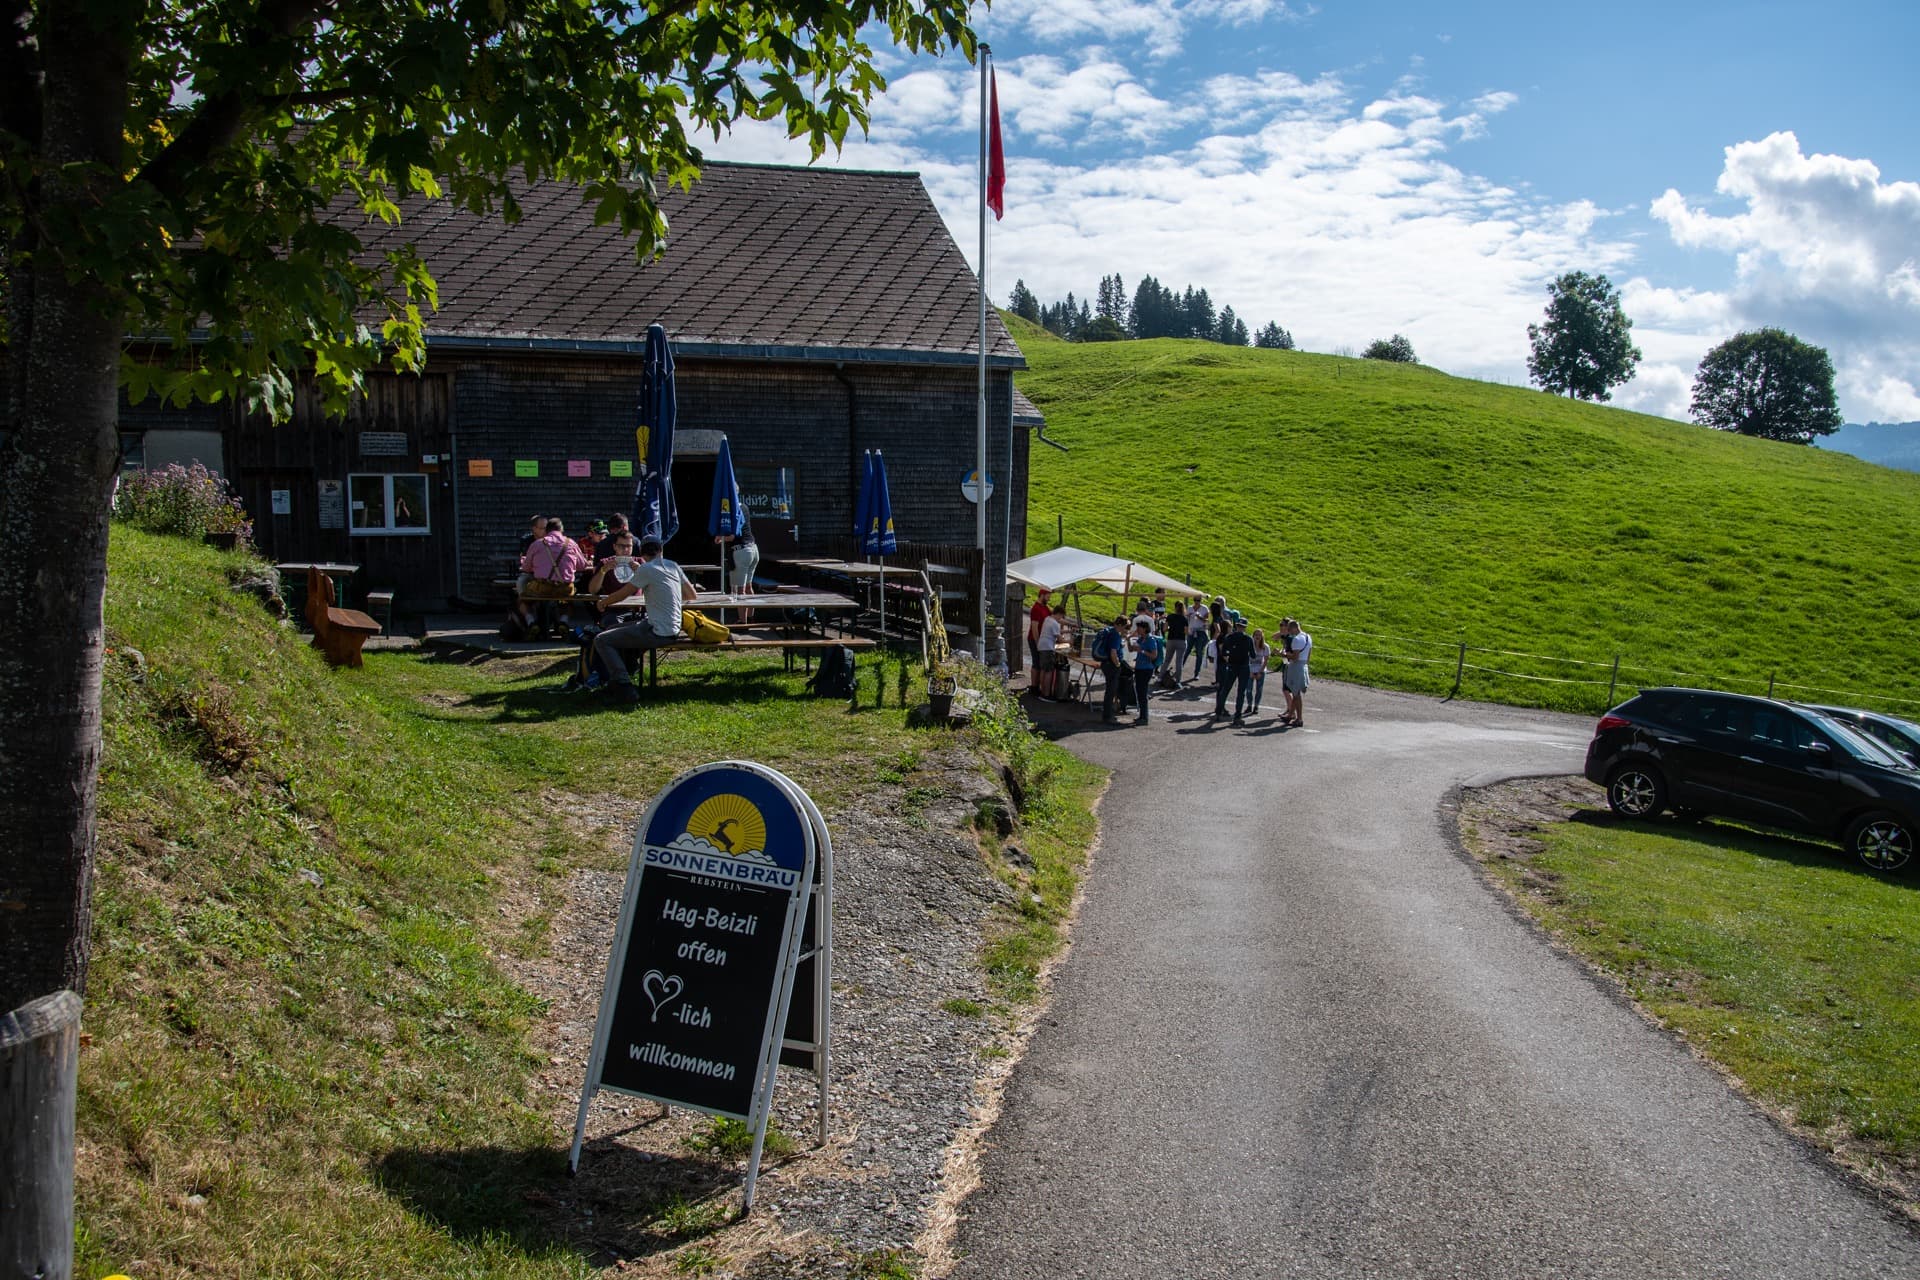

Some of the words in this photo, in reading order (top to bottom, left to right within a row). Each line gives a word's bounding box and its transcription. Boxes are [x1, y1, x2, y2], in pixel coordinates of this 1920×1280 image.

[645, 848, 796, 887] SONNENBRÄU
[690, 876, 742, 892] REBSTEIN
[662, 898, 758, 936] Hag-Beizli
[677, 940, 727, 967] offen
[629, 1041, 736, 1082] willkommen
